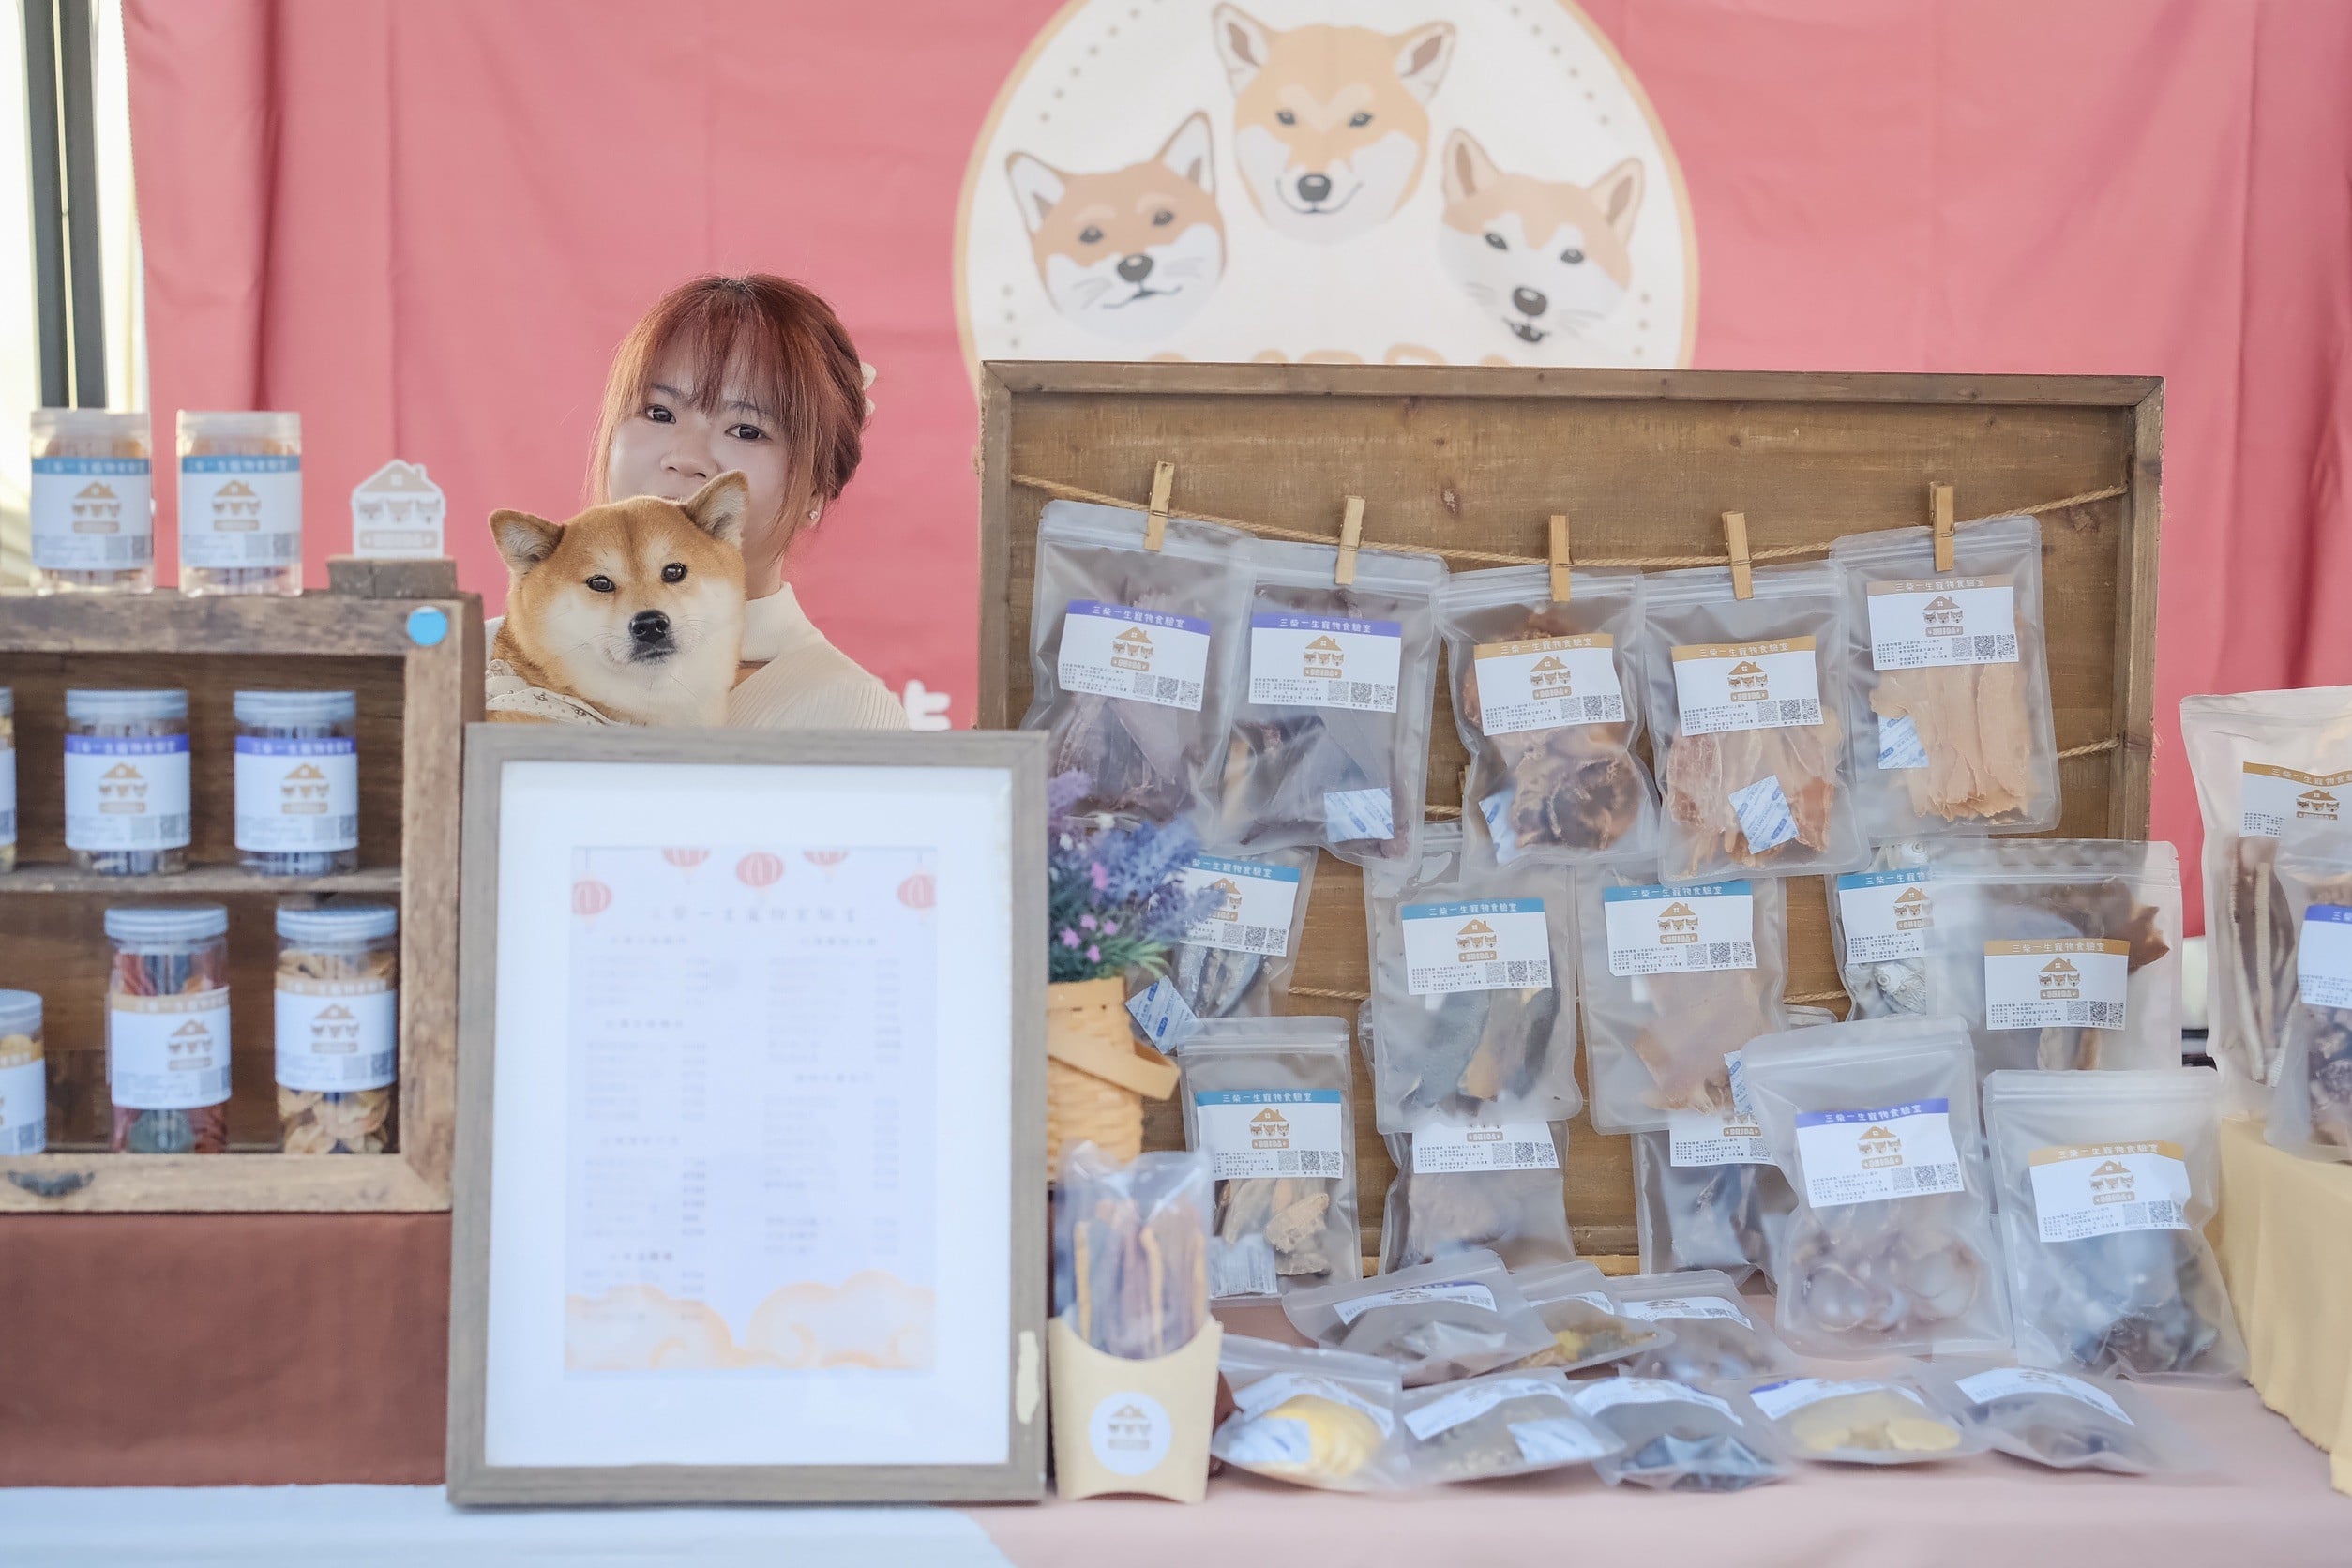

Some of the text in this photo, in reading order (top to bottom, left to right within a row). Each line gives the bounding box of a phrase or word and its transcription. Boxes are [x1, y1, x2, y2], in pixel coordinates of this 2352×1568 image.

[1092, 606, 1184, 629] 三柴一生寵物食驗室
[1279, 618, 1372, 634] 三柴一生寵物食驗室
[1192, 858, 1273, 878] 柴一生寵物食驗室
[1429, 903, 1518, 916] 三柴一生寵物食驗室
